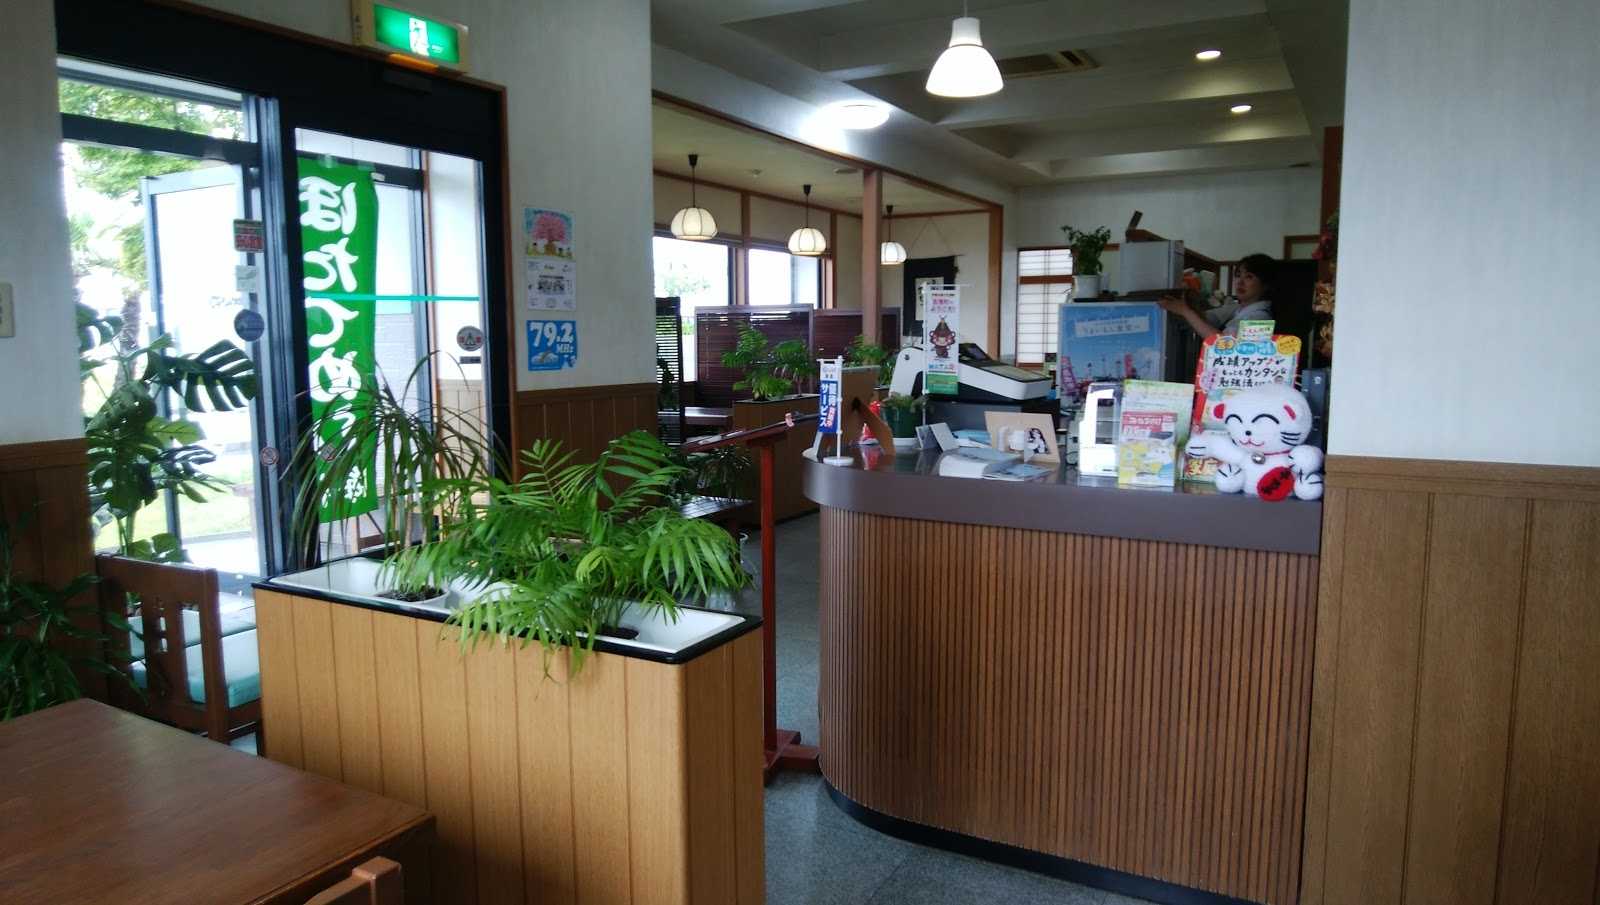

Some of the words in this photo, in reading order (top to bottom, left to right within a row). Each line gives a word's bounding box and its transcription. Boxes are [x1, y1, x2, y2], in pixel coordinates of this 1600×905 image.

[529, 321, 574, 347] 79.2
[819, 383, 829, 427] サービス
